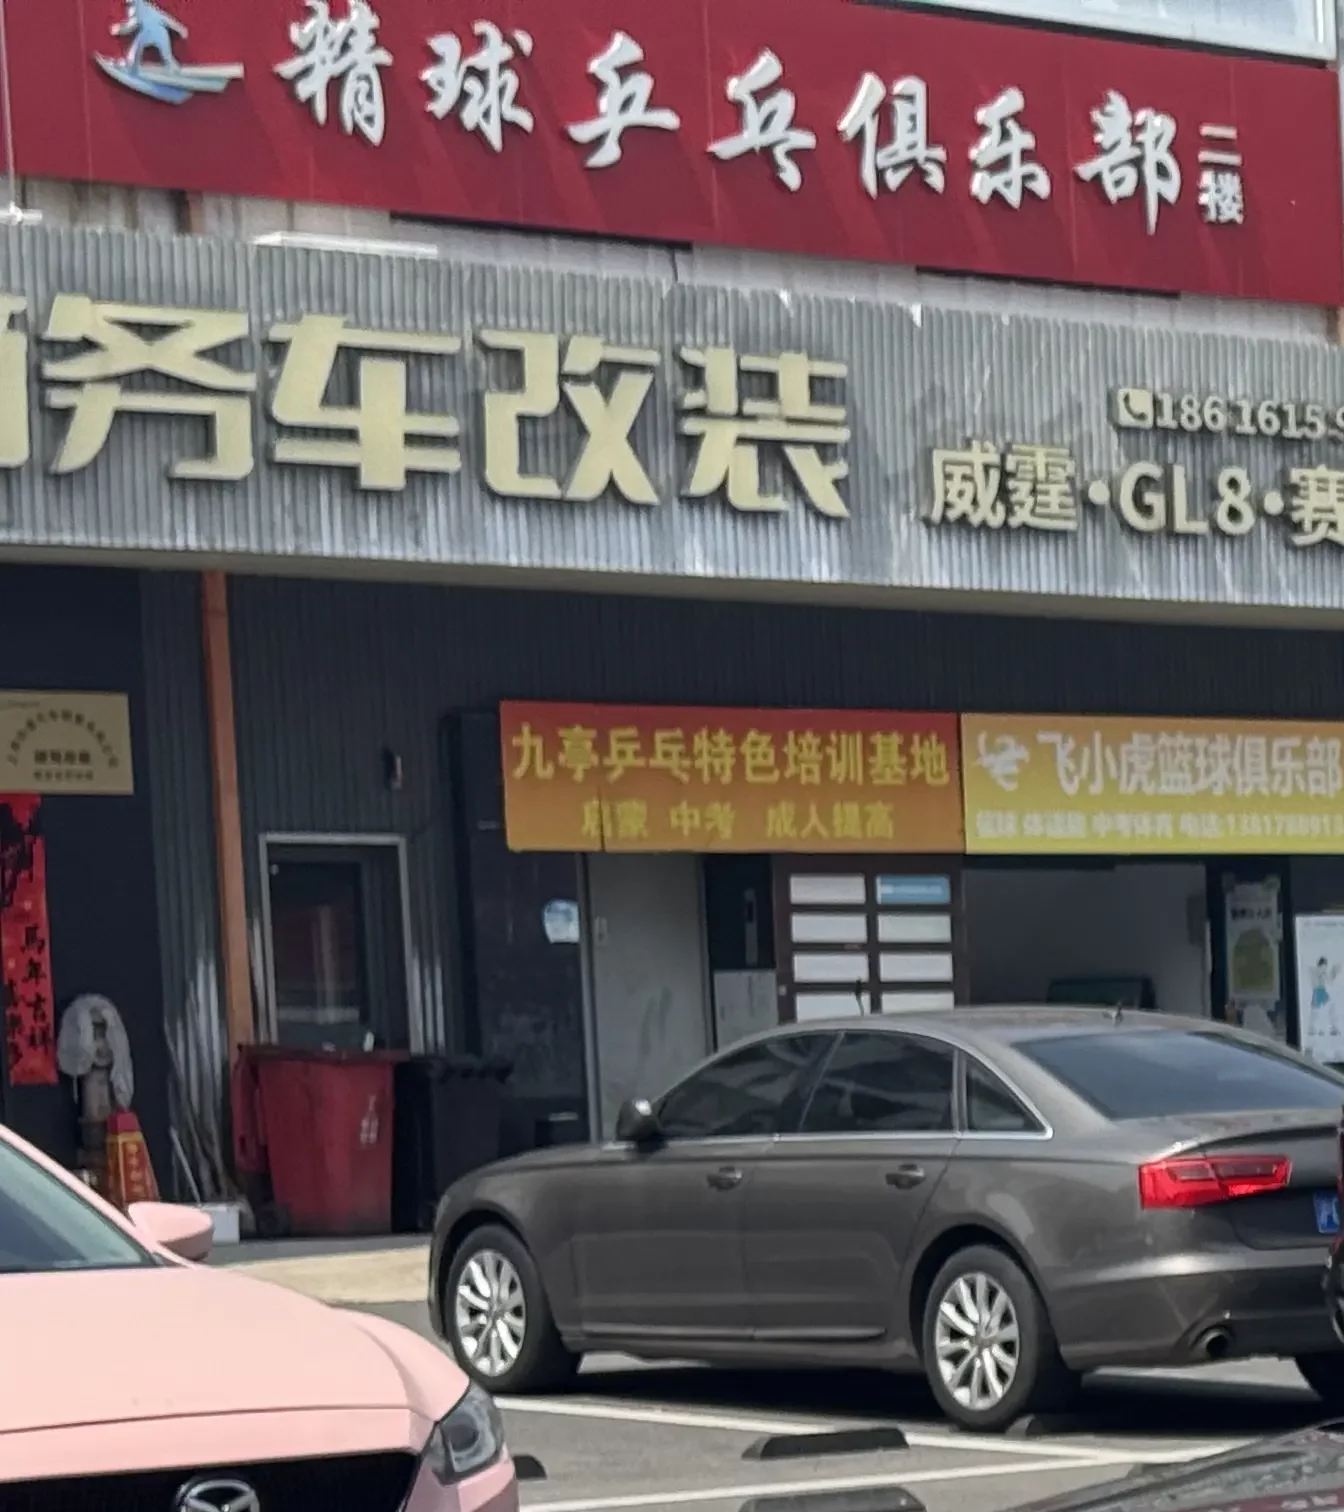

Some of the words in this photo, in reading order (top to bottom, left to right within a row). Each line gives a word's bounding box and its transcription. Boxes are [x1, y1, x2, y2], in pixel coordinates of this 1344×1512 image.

[274, 0, 1183, 235] 精球乒乓俱乐部
[1198, 125, 1245, 225] 二楼
[0, 294, 851, 519] 务车改装
[510, 721, 951, 788] 九亭乒乓特色培训基地
[1036, 731, 1343, 800] 飞小虎篮球俱乐部
[668, 800, 736, 840] 中考
